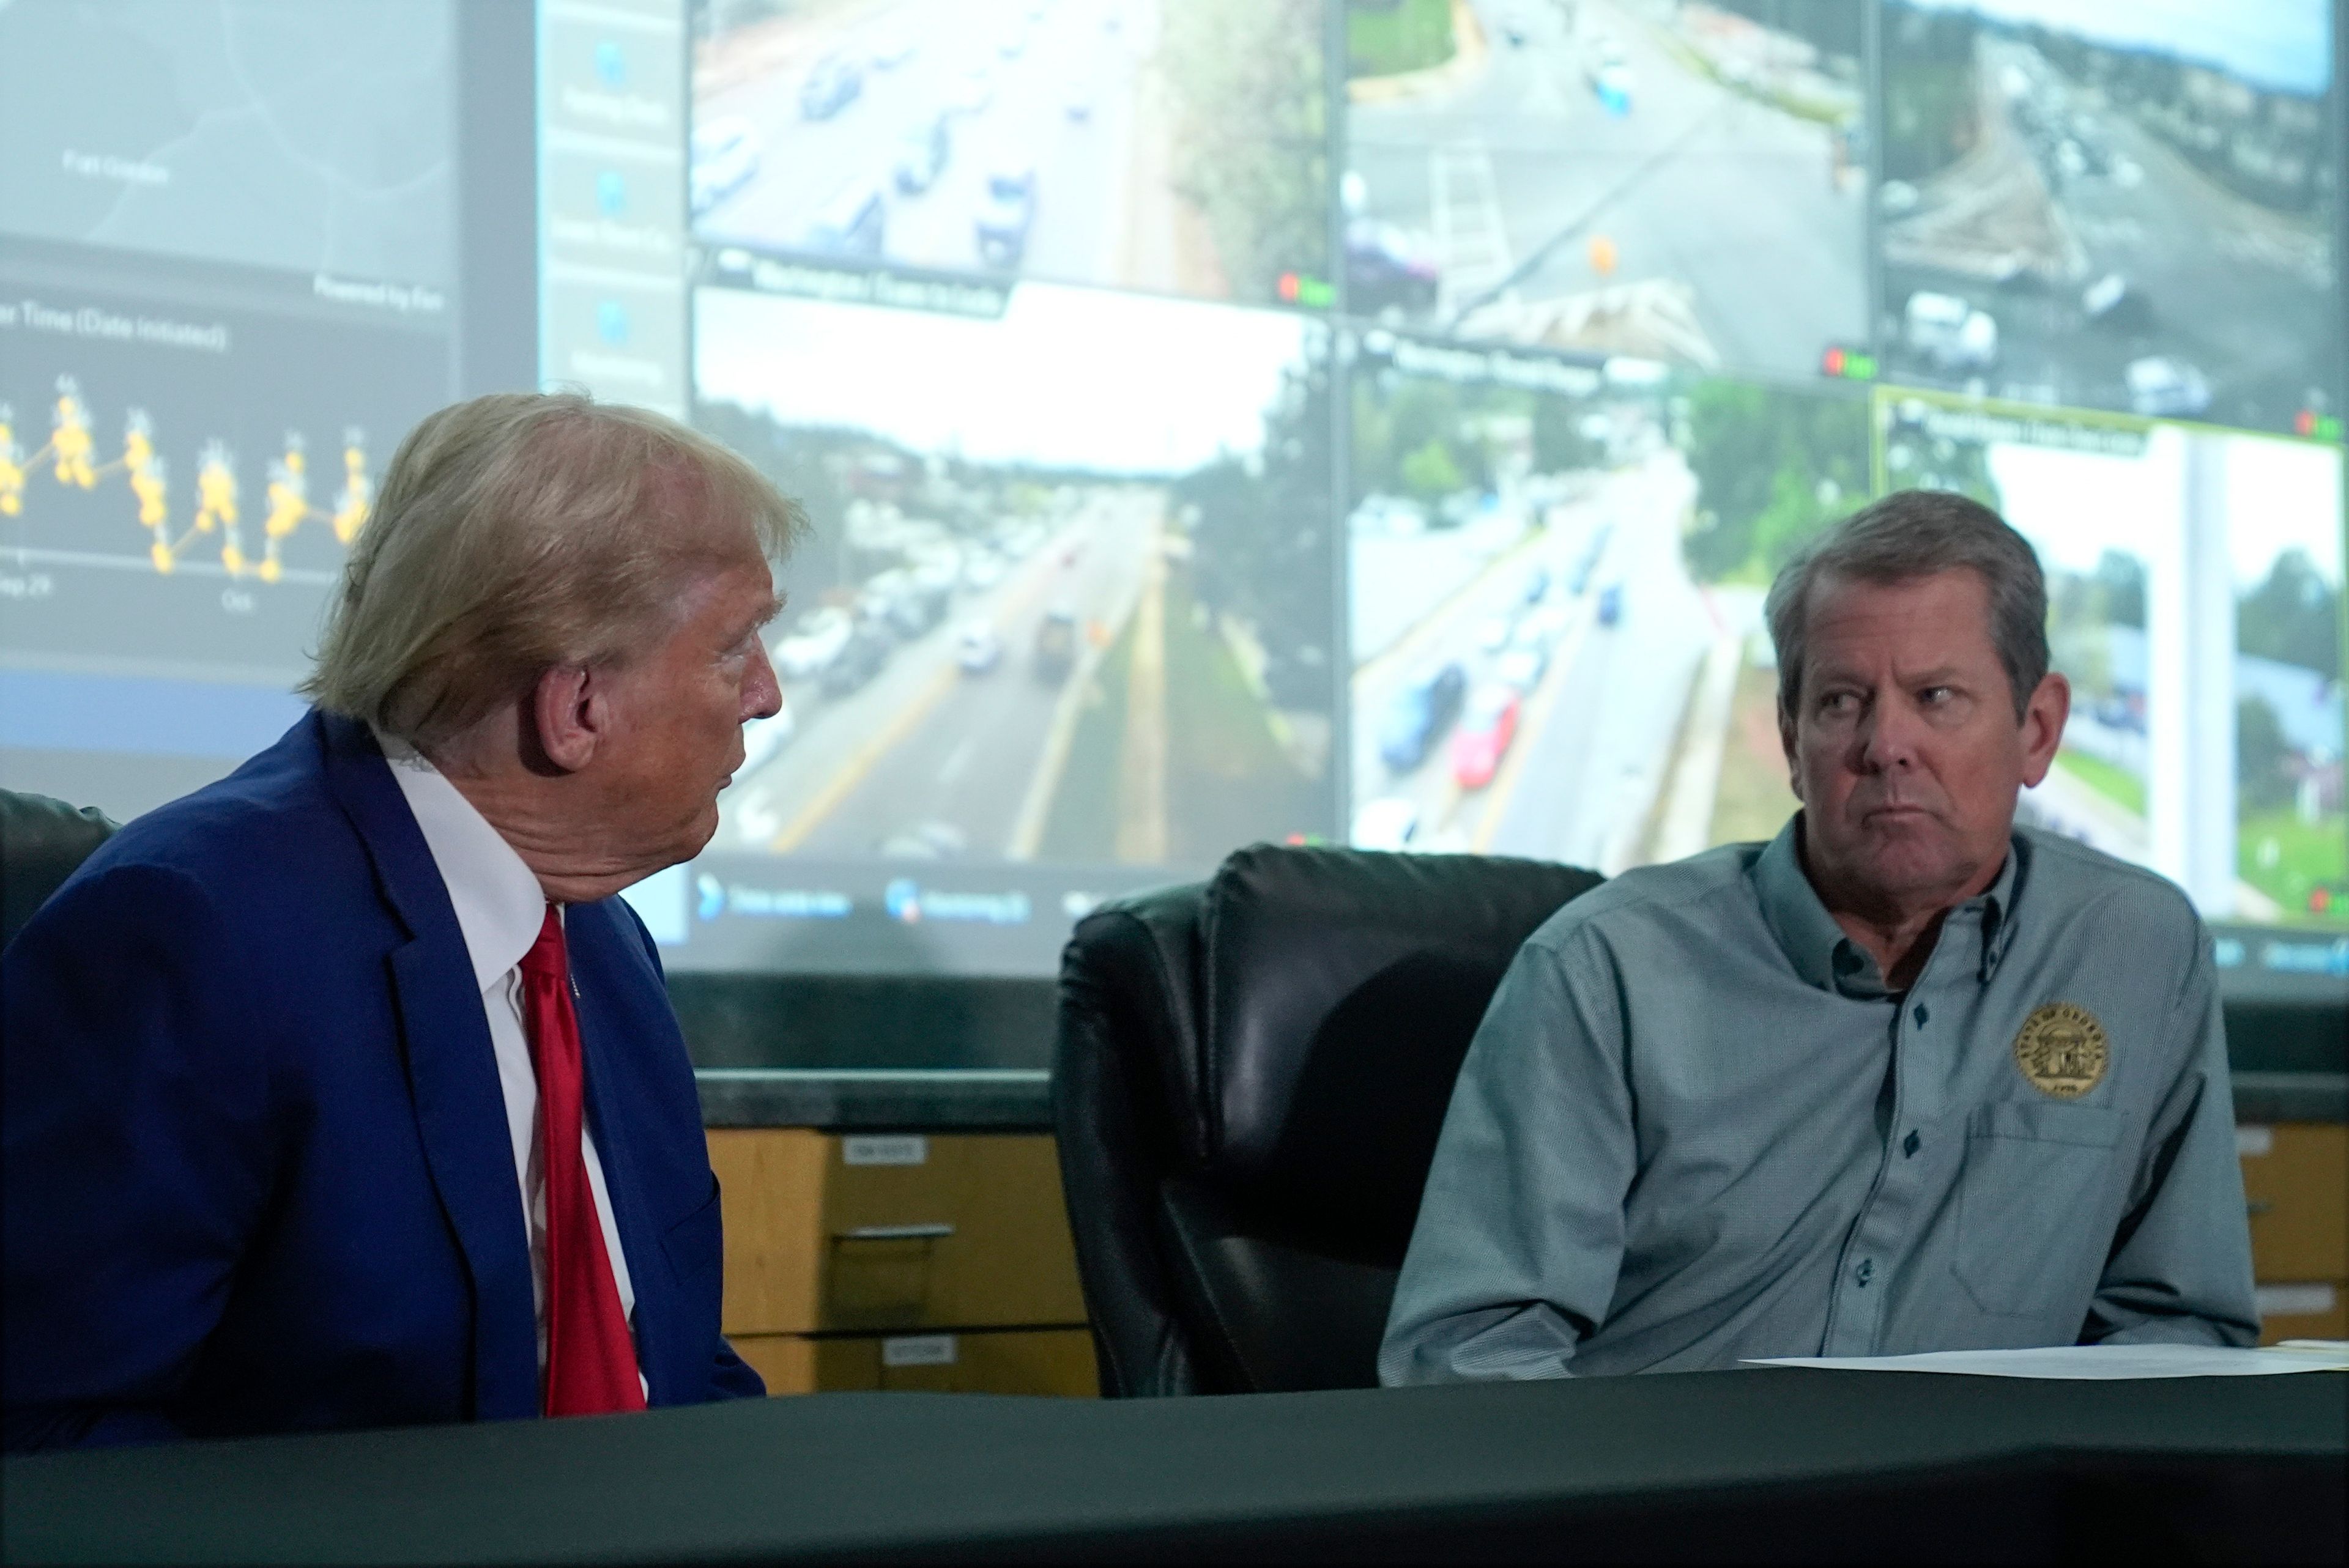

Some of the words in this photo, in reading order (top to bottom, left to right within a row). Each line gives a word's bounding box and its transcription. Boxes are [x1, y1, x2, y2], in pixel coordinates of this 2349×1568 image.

[23, 300, 73, 331] Time
[76, 308, 133, 338] (Date
[137, 316, 228, 353] Initiated)
[2062, 1007, 2103, 1059] GEORGIA
